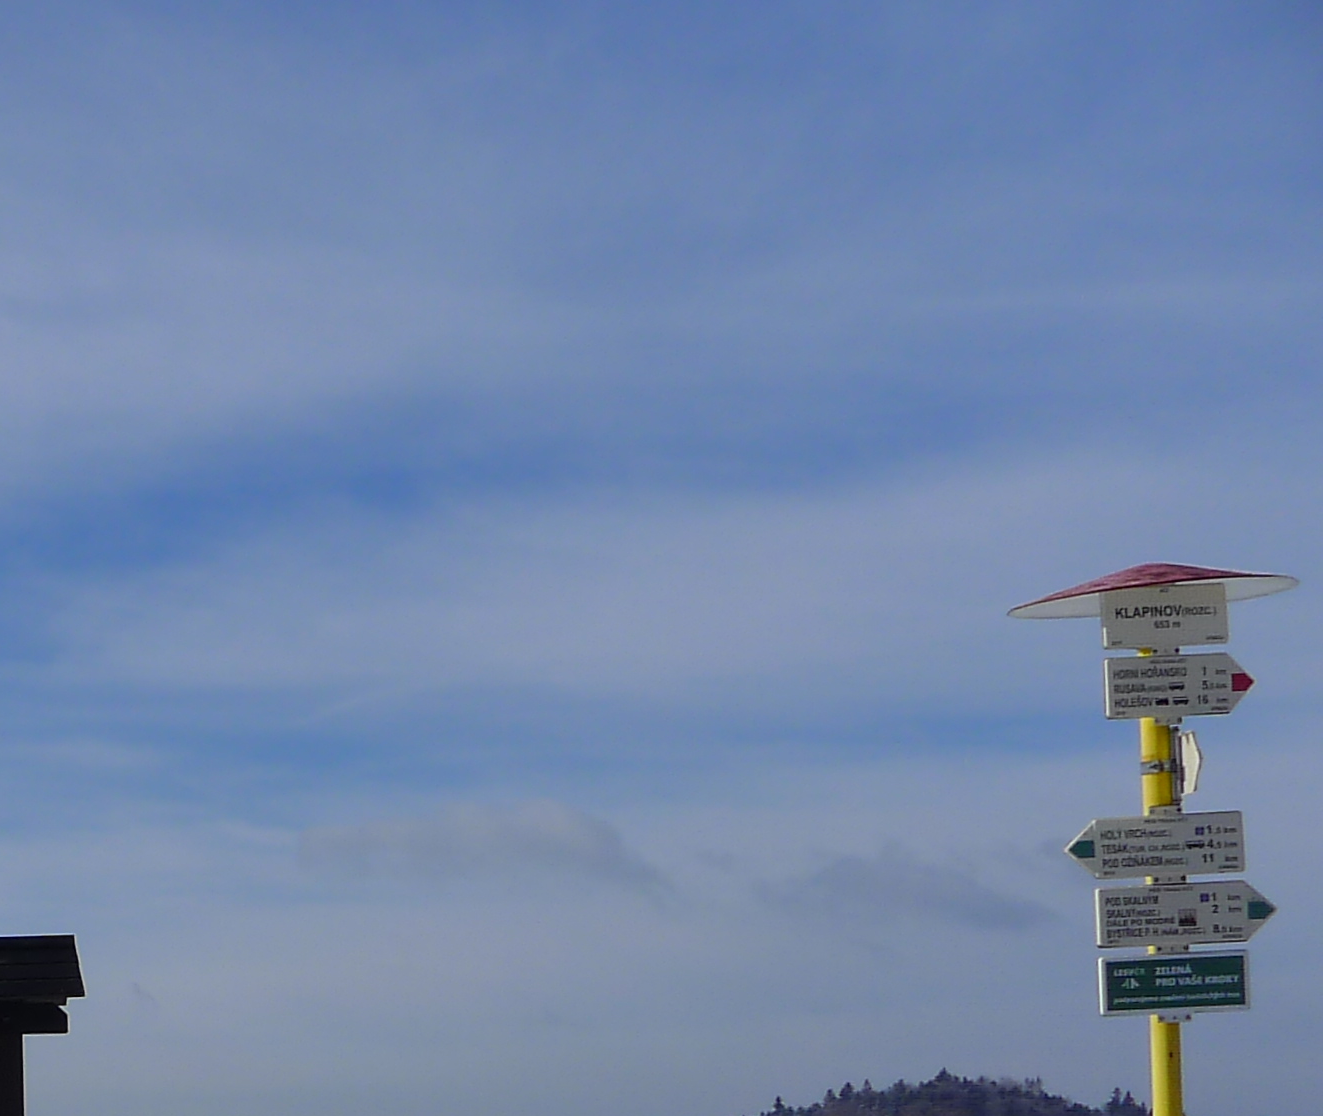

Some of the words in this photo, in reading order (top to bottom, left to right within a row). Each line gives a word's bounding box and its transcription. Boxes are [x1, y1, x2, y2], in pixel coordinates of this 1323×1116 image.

[1202, 667, 1207, 676] 1
[1202, 853, 1214, 863] 11
[1212, 905, 1219, 913] 2
